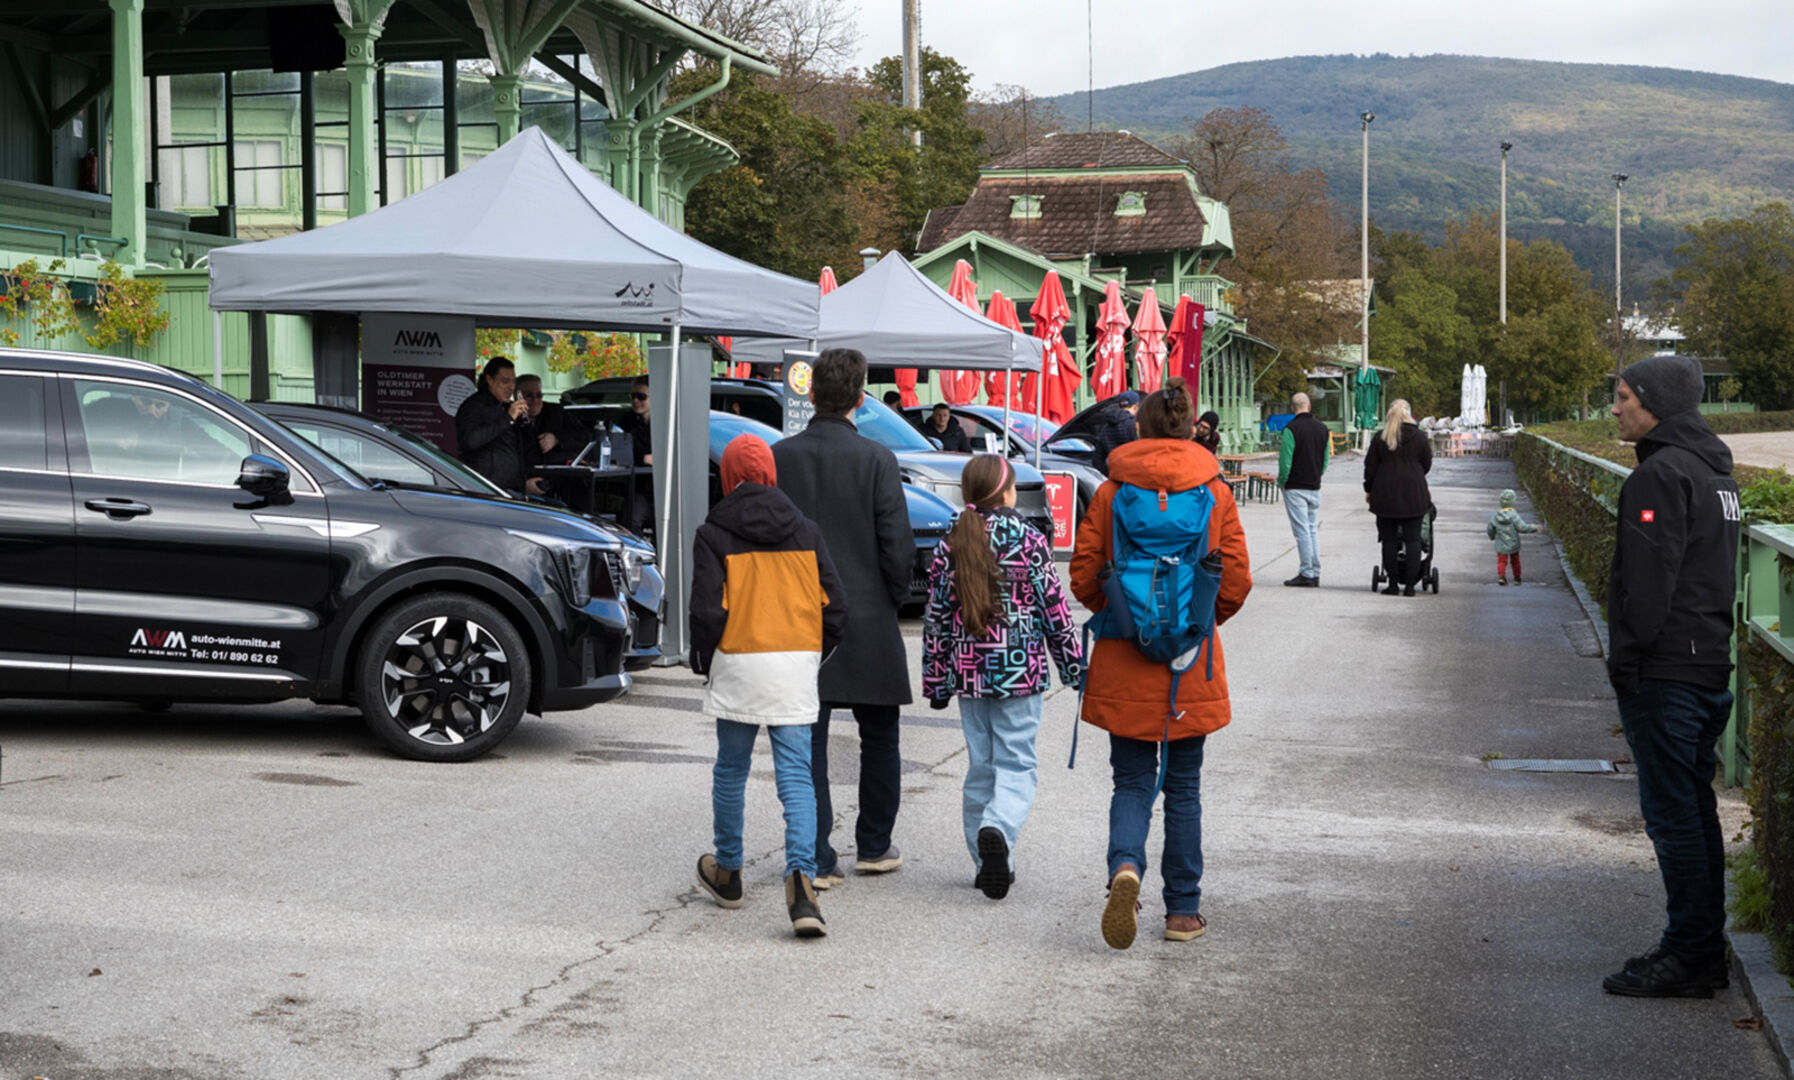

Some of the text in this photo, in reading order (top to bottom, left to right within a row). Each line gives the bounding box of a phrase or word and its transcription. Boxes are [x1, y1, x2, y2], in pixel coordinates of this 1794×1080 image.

[377, 371, 425, 380] OLDTIMER
[377, 380, 432, 389] WERKSTATT
[377, 388, 413, 397] IN WIEN
[788, 398, 815, 408] Der vo
[788, 409, 800, 418] Kia
[788, 420, 801, 430] Car
[191, 634, 281, 649] auto-wienmitte.at
[191, 649, 278, 664] Tel: 01/ 890 62 62
